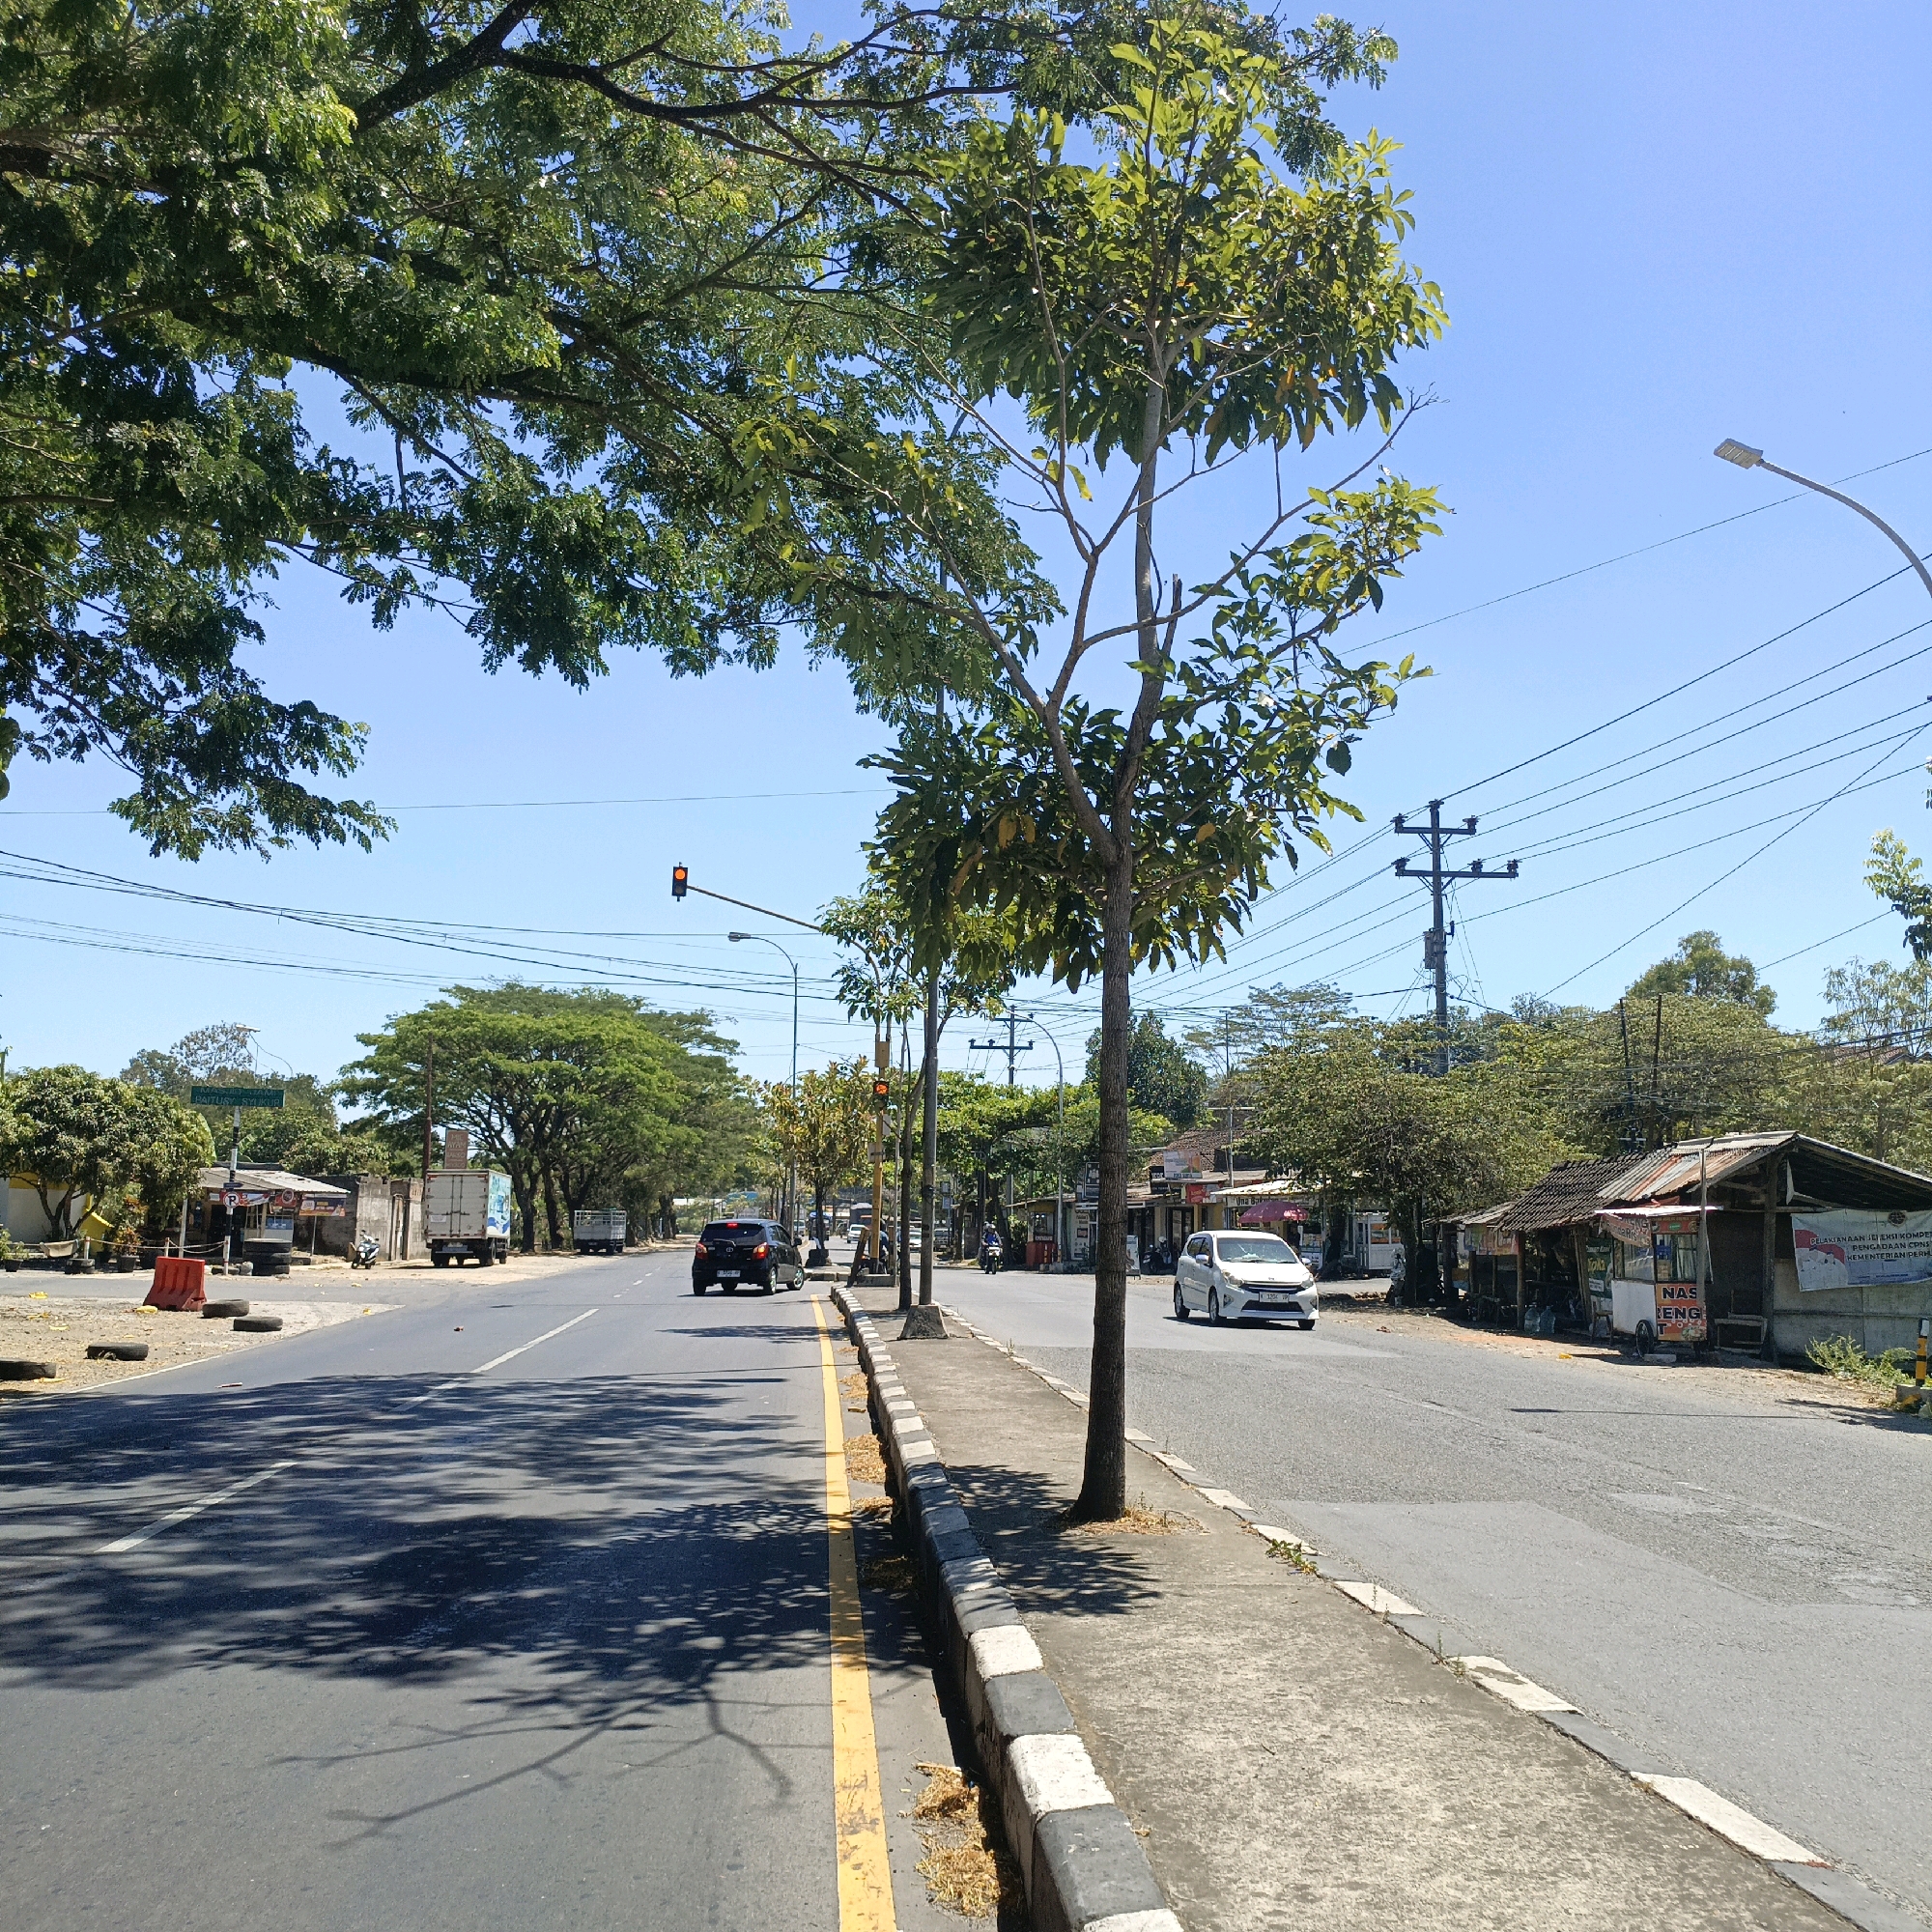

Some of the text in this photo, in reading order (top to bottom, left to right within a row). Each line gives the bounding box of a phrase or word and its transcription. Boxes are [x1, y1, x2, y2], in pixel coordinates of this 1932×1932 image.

[242, 1097, 280, 1107] SYUKUR
[1810, 1235, 1865, 1245] PELAKSANAAN
[1853, 1240, 1929, 1251] PENGADAAN CPNS
[1847, 1252, 1906, 1261] KEMENTERIAN
[1662, 1287, 1697, 1299] NAS
